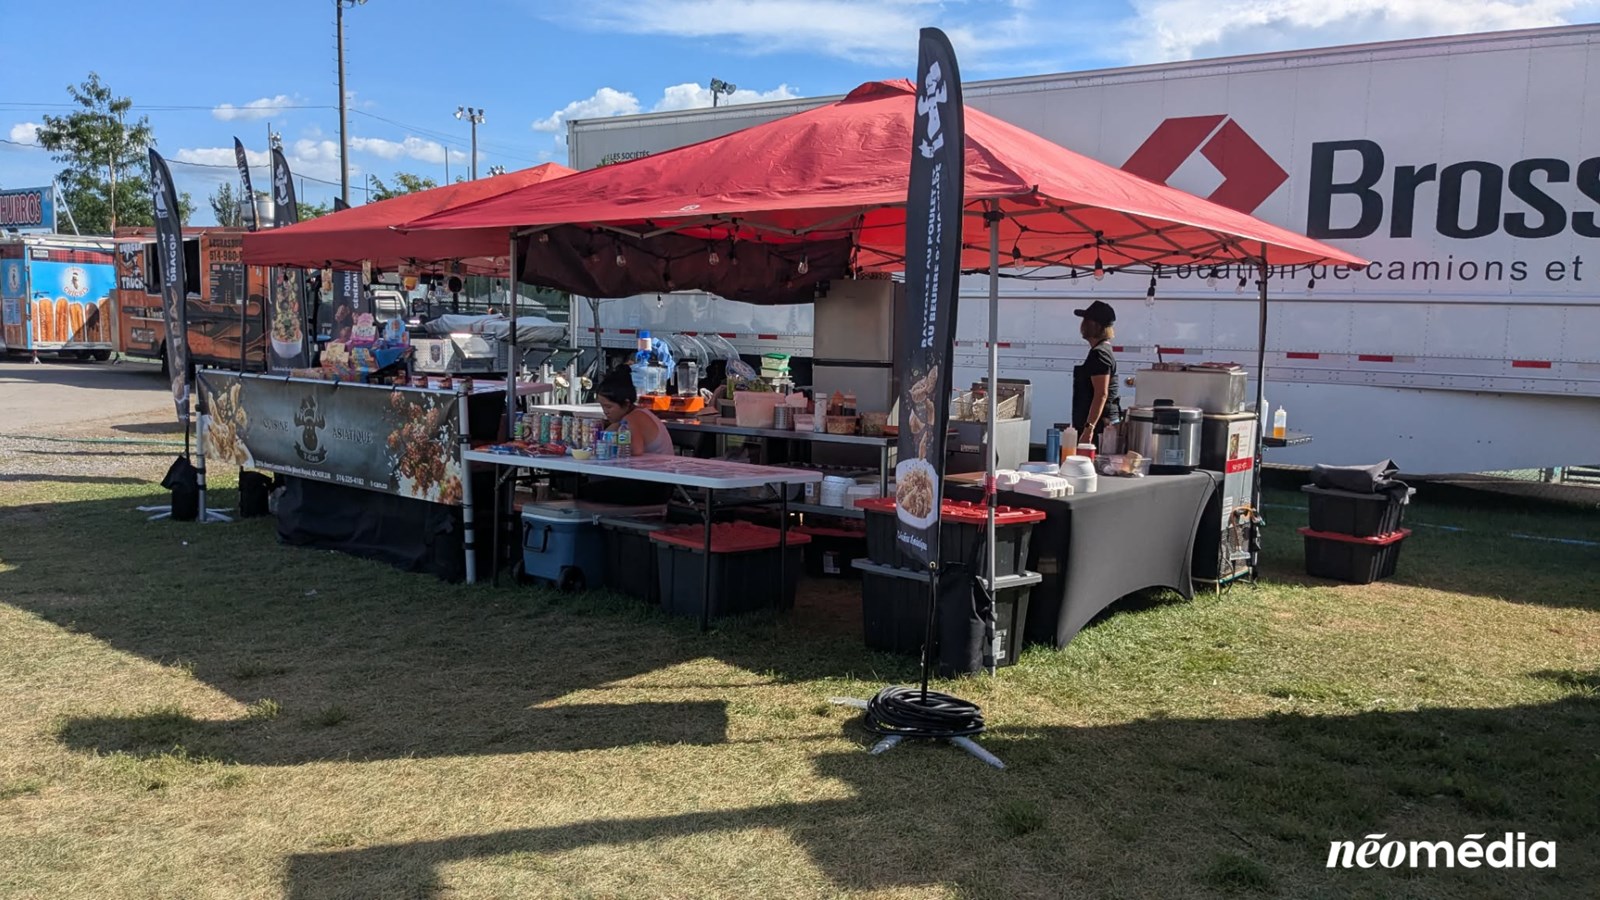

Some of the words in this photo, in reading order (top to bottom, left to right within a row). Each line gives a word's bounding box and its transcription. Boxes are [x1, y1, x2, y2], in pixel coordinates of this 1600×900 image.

[0, 192, 42, 225] HURROS
[1366, 255, 1528, 282] camions
[1545, 255, 1583, 282] et
[927, 325, 933, 347] AU
[930, 264, 939, 321] BEURRE
